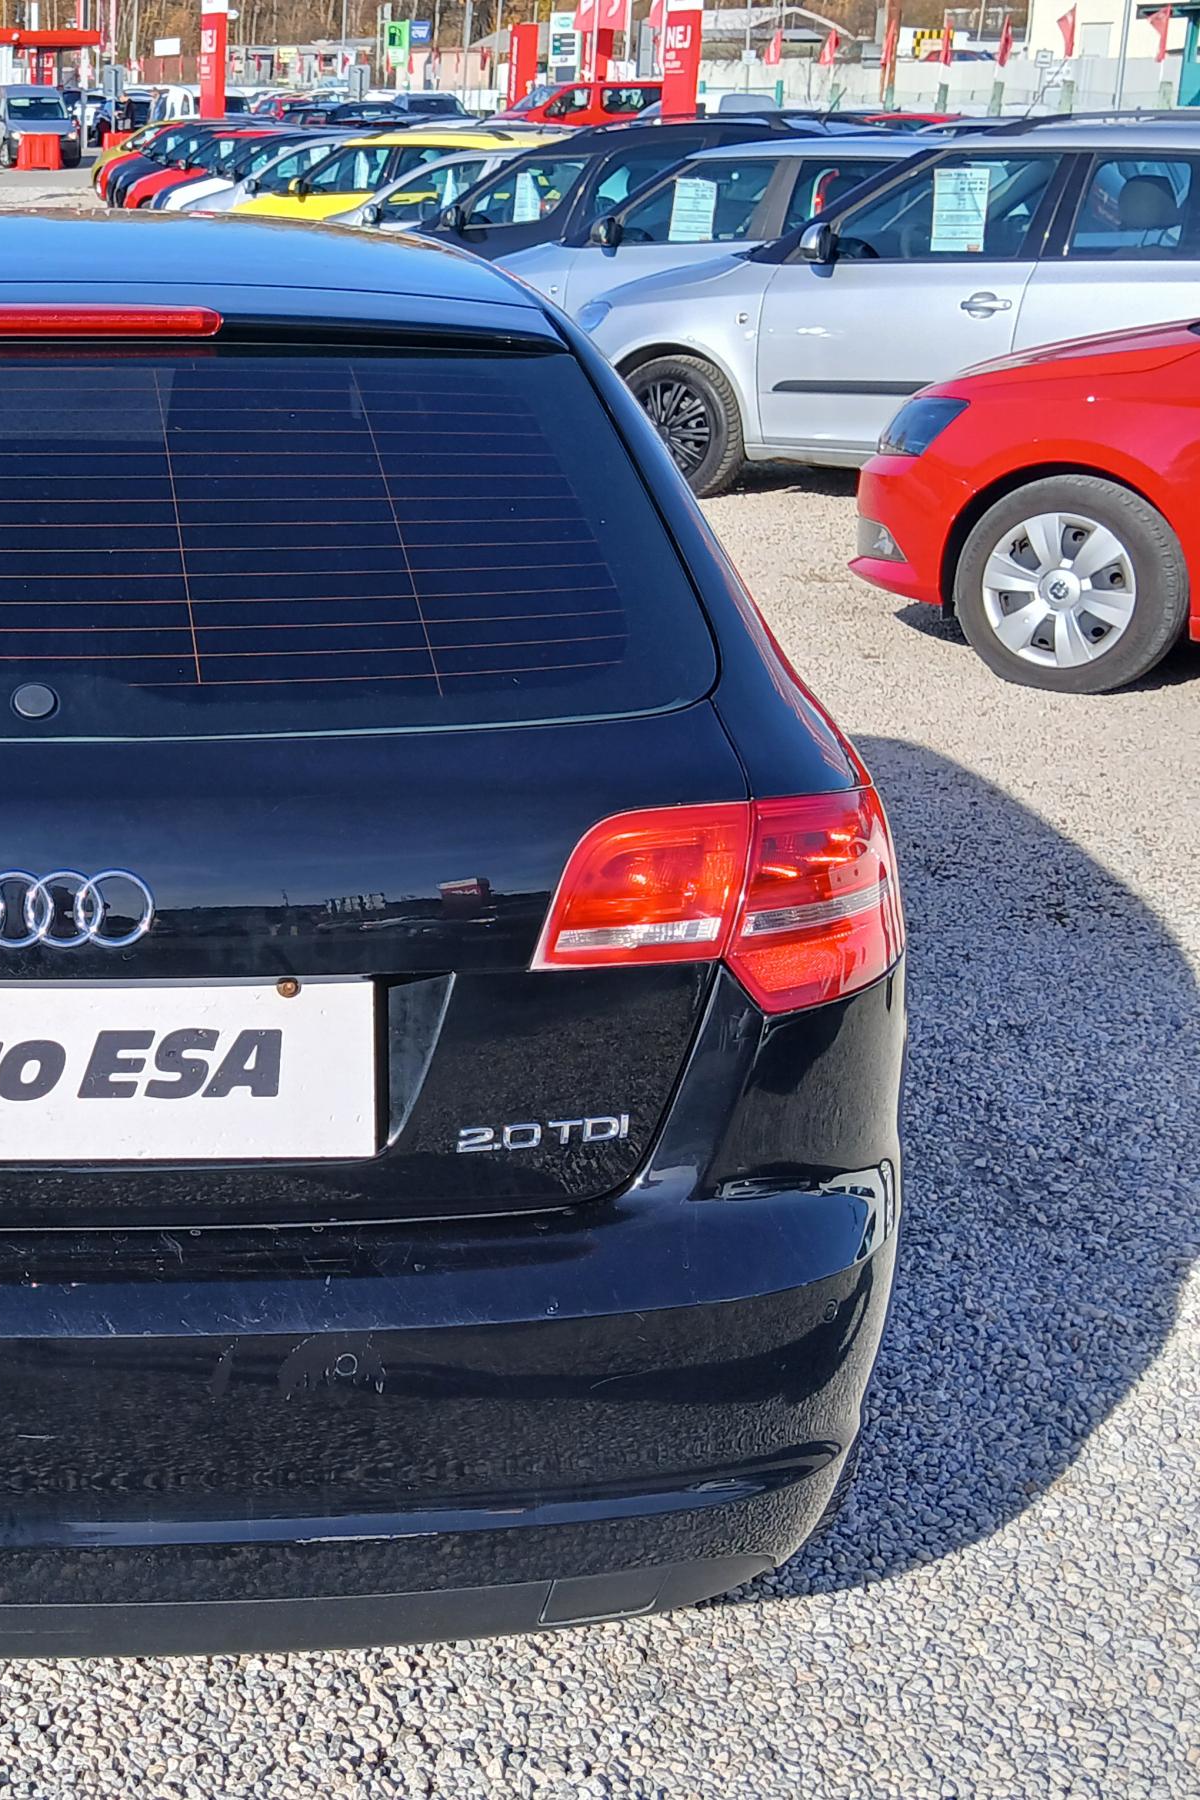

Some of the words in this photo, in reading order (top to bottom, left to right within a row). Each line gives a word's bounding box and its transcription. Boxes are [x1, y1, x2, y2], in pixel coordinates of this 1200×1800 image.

[666, 24, 692, 49] NEJ
[76, 1027, 283, 1100] ESA
[456, 1123, 542, 1154] 2.0
[547, 1113, 630, 1146] TDI
